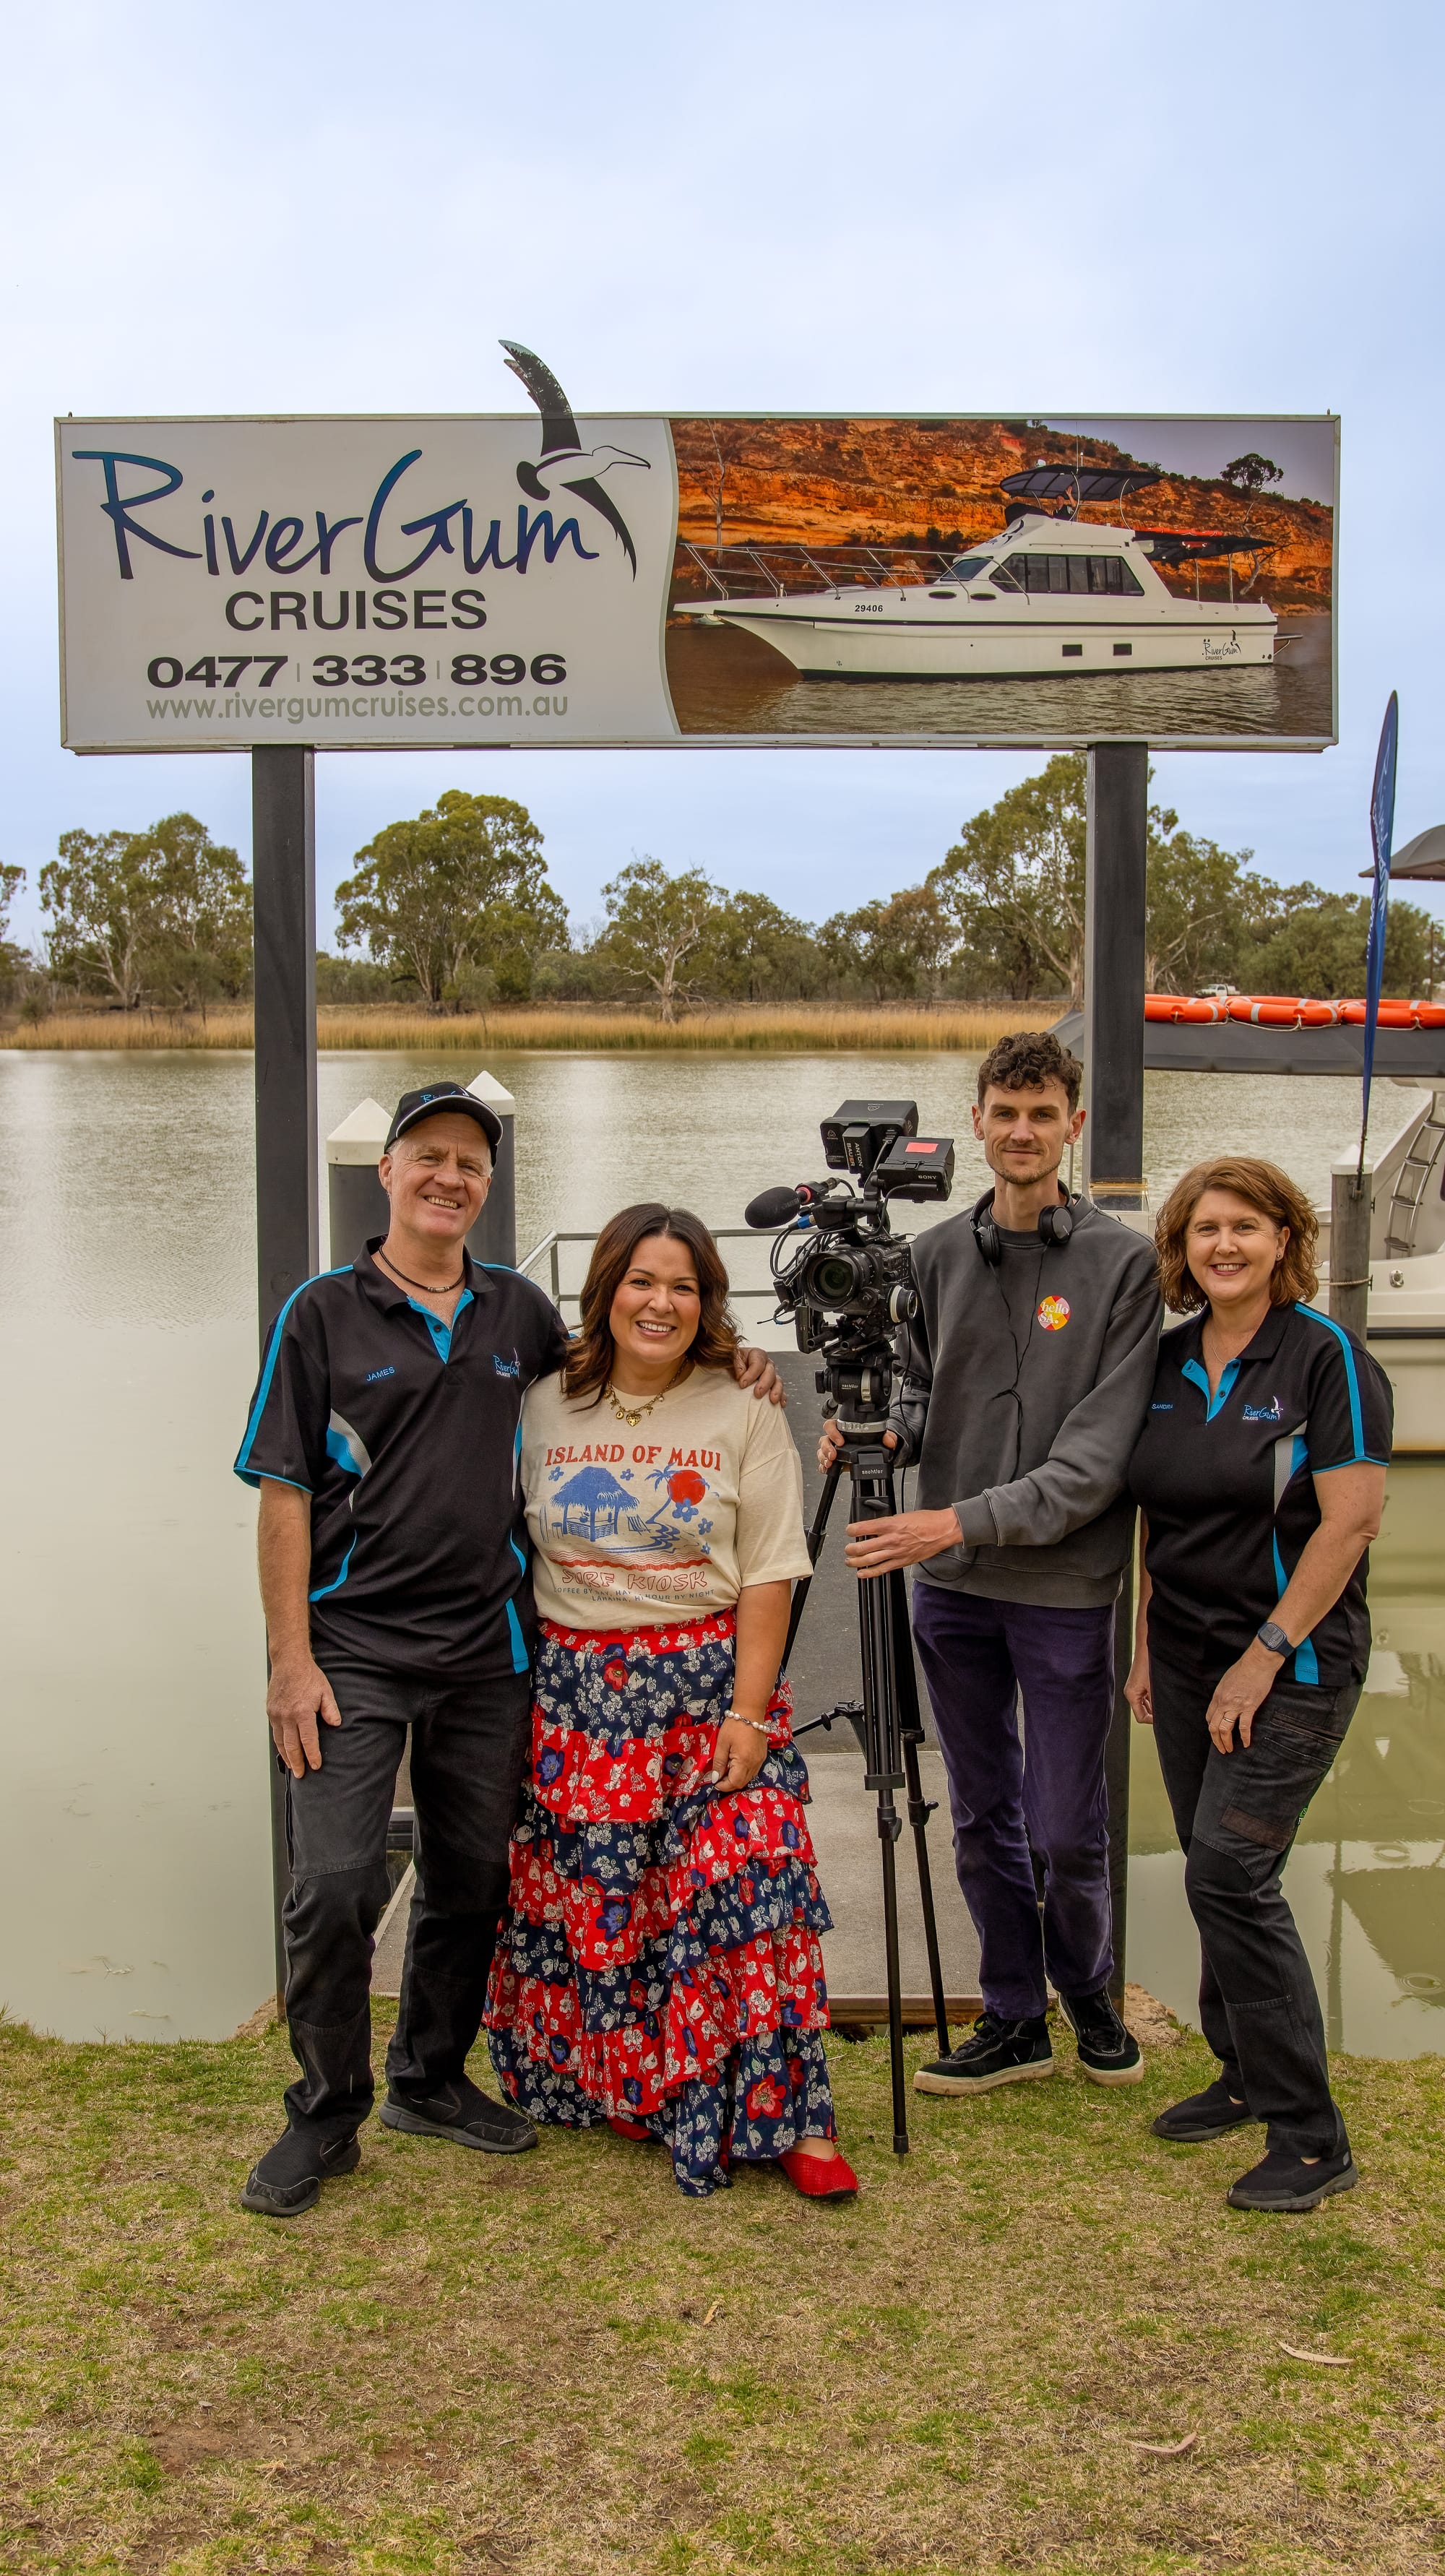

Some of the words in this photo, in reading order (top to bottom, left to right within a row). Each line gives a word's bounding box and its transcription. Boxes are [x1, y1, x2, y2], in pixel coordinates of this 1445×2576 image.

[225, 589, 488, 631] CRUISES
[147, 654, 288, 688] 0477
[312, 654, 427, 687] 333
[450, 653, 567, 686] 896
[146, 692, 569, 725] www.rivergumcruises.com.au
[846, 1143, 855, 1167] BAUER
[854, 1142, 863, 1167] ANTON
[1040, 1313, 1058, 1324] SA.
[1041, 1301, 1069, 1315] hello
[366, 1367, 395, 1381] JAMES
[545, 1444, 625, 1467] ISLAND
[632, 1445, 662, 1464] OF
[668, 1447, 722, 1471] MAUI
[561, 1569, 615, 1588] SURF
[627, 1571, 708, 1591] KIOSK
[689, 1589, 715, 1599] NIGHT
